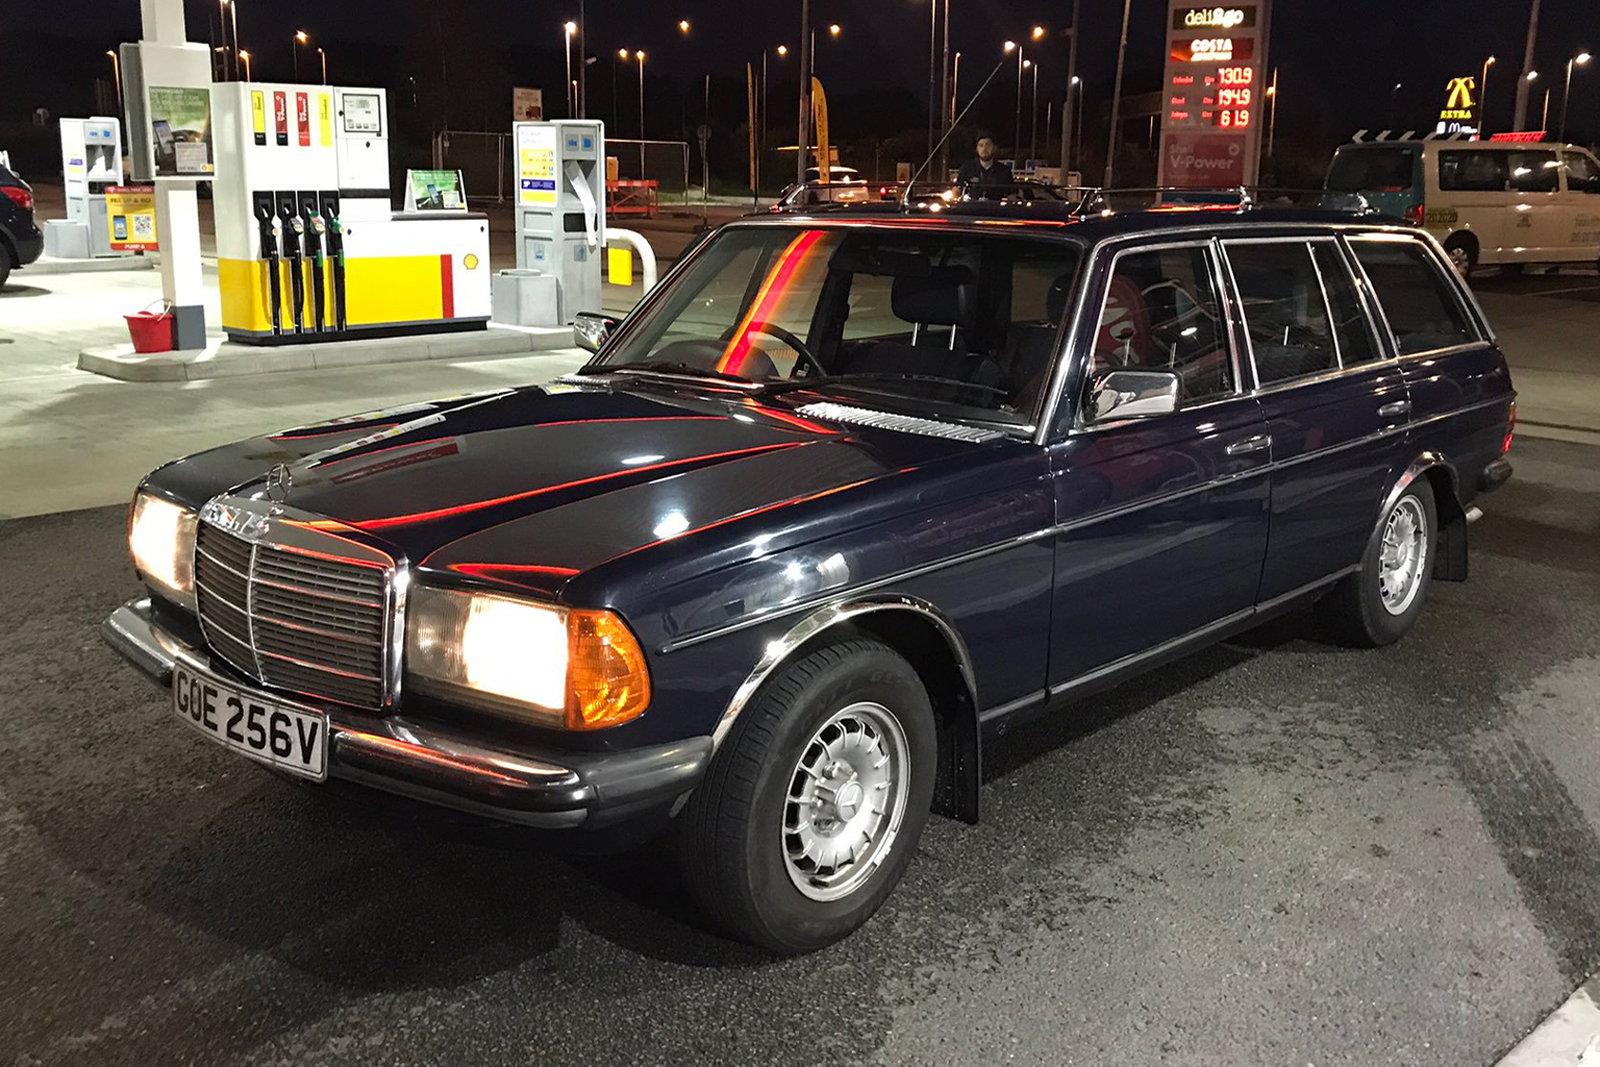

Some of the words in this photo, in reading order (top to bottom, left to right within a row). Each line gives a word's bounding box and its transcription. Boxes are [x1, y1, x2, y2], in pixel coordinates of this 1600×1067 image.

[1191, 38, 1233, 52] COSTA
[1169, 143, 1194, 154] Shell
[1169, 155, 1234, 170] V-Power
[176, 670, 218, 732] GOE
[226, 697, 319, 765] 256V
